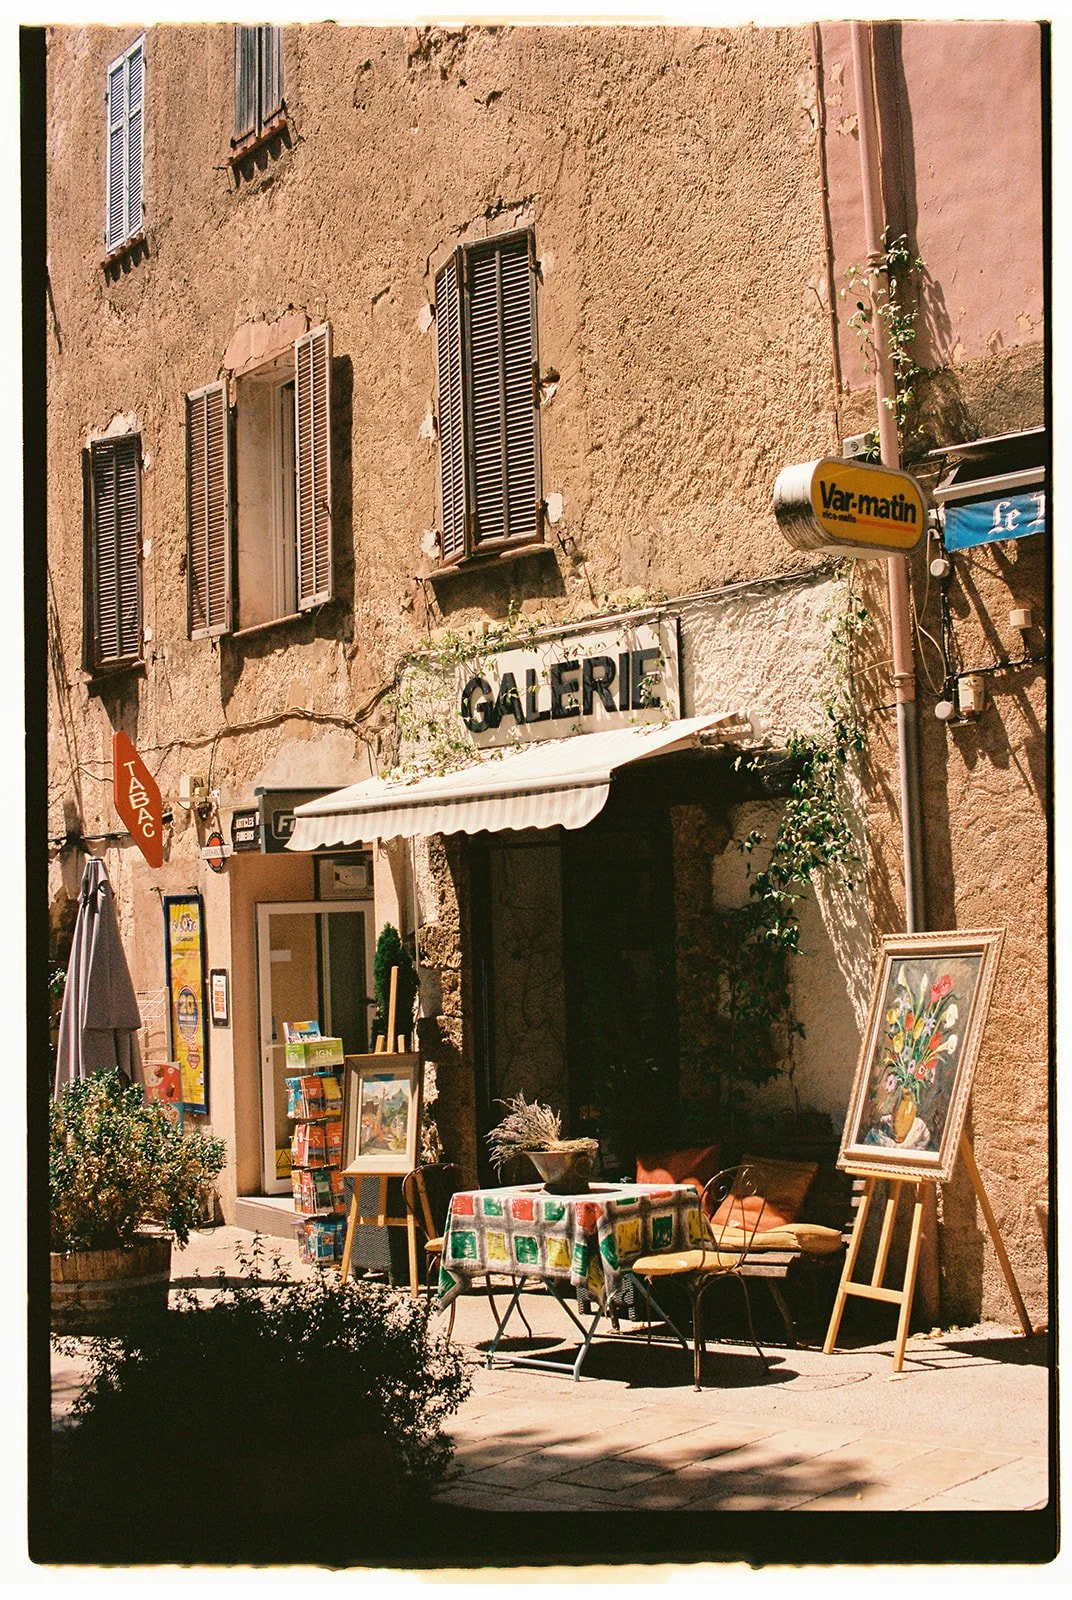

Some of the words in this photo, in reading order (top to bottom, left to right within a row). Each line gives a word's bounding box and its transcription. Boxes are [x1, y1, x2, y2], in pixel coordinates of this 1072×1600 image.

[819, 480, 917, 524] Var-matin
[988, 501, 1022, 535] Le
[461, 647, 662, 734] GALERIE
[123, 760, 156, 839] TABAC
[315, 1049, 333, 1059] IGN
